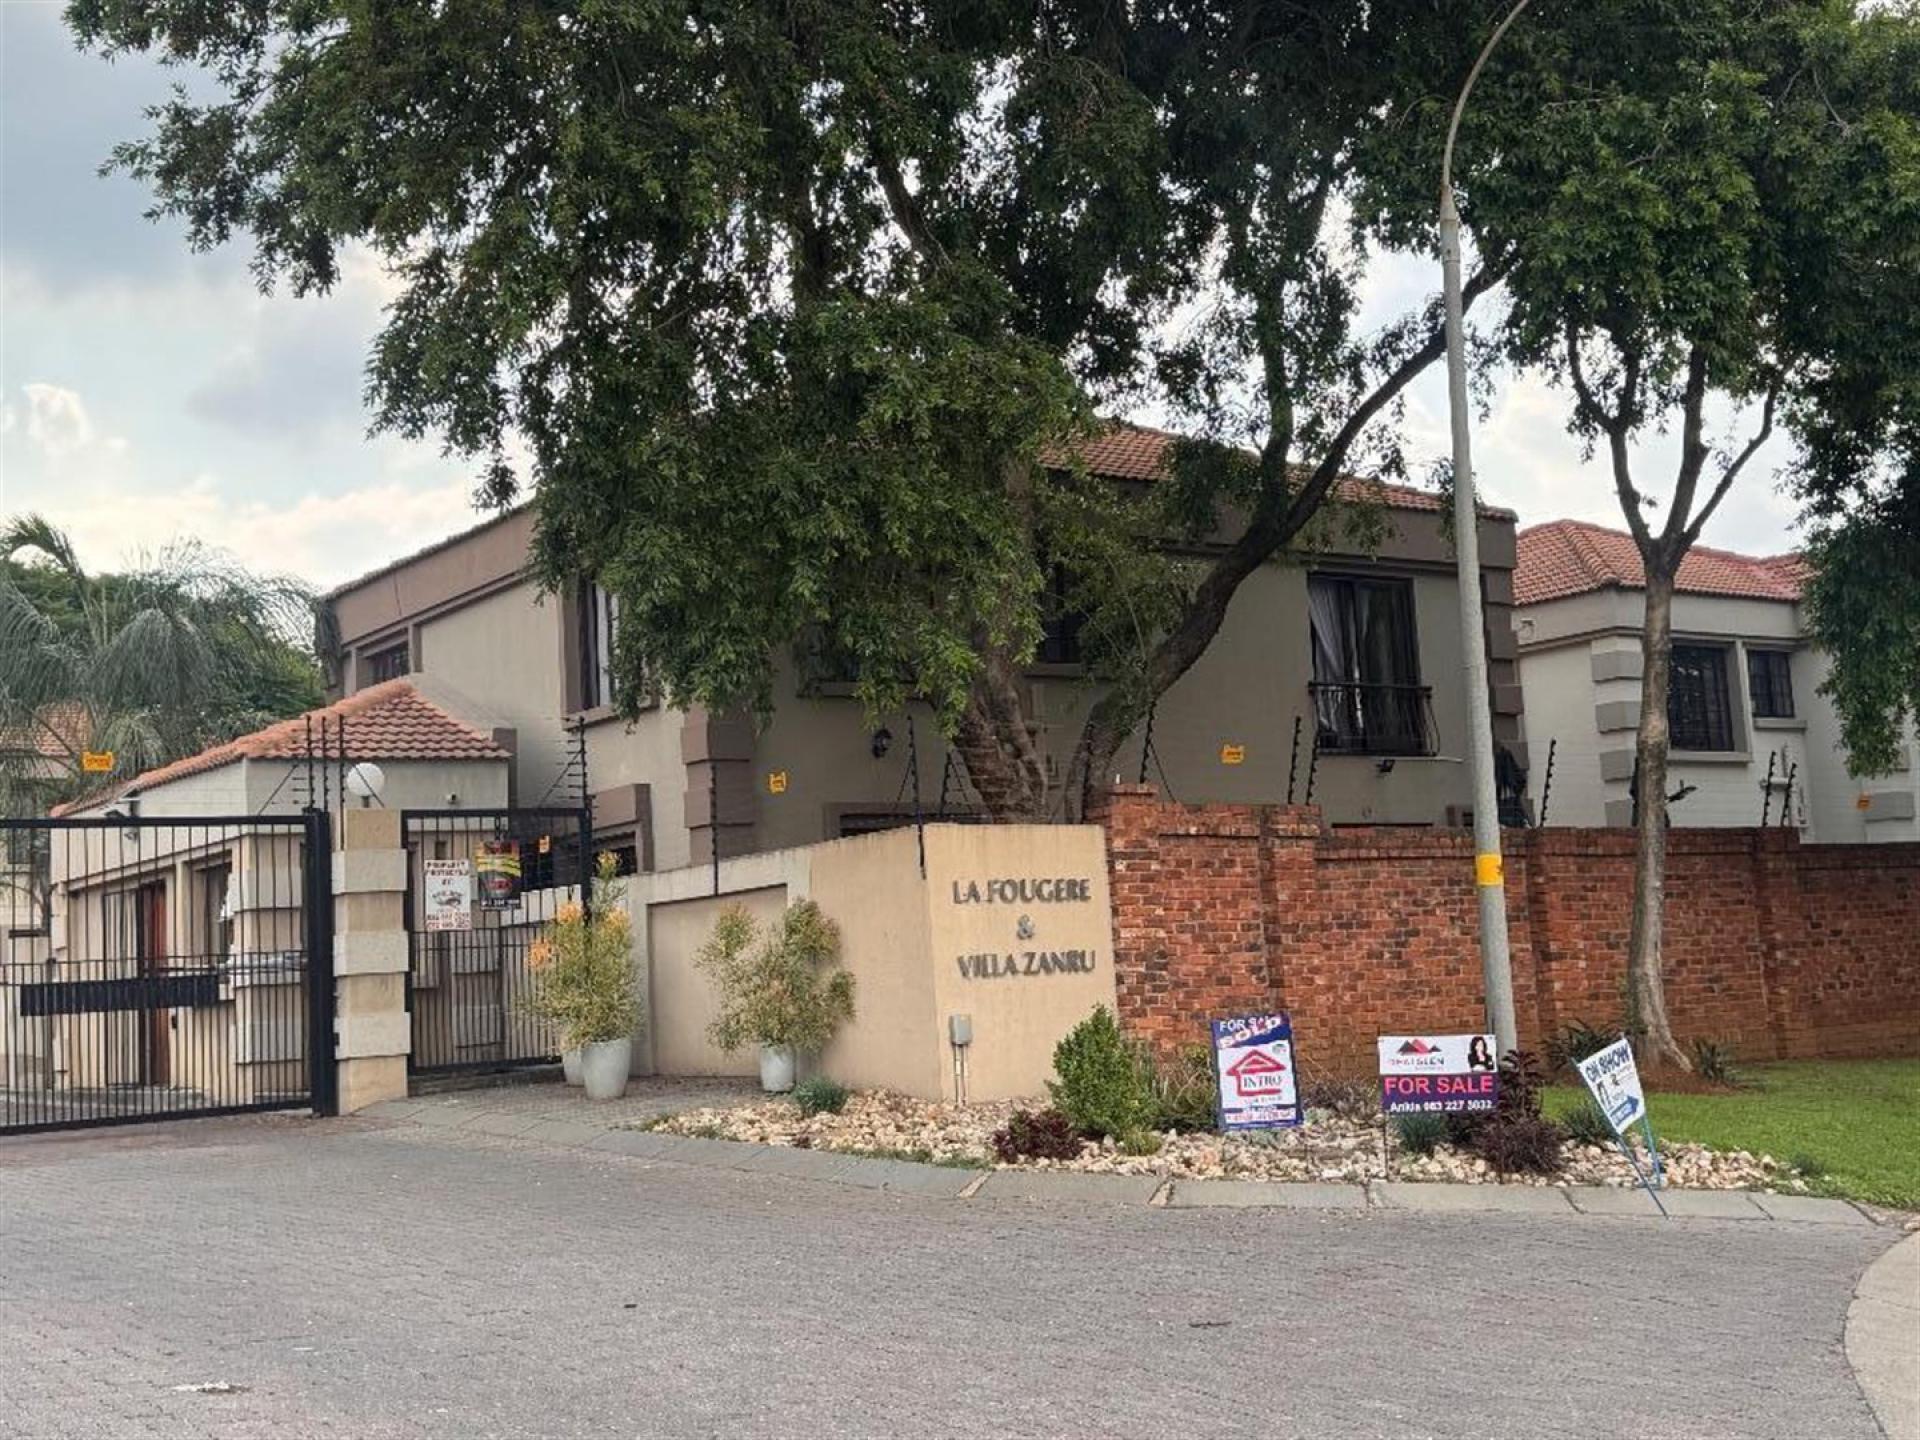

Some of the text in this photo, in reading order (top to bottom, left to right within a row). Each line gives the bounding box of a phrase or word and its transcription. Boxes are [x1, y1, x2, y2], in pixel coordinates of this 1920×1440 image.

[953, 879, 1092, 904] LA FOUGERE
[1017, 914, 1034, 940] &
[956, 950, 1096, 979] VILLA ZANRU
[1220, 1018, 1245, 1032] FOR
[1598, 1043, 1632, 1075] SHOW
[1243, 1075, 1282, 1088] INTRO
[1384, 1075, 1493, 1095] FOR SALE
